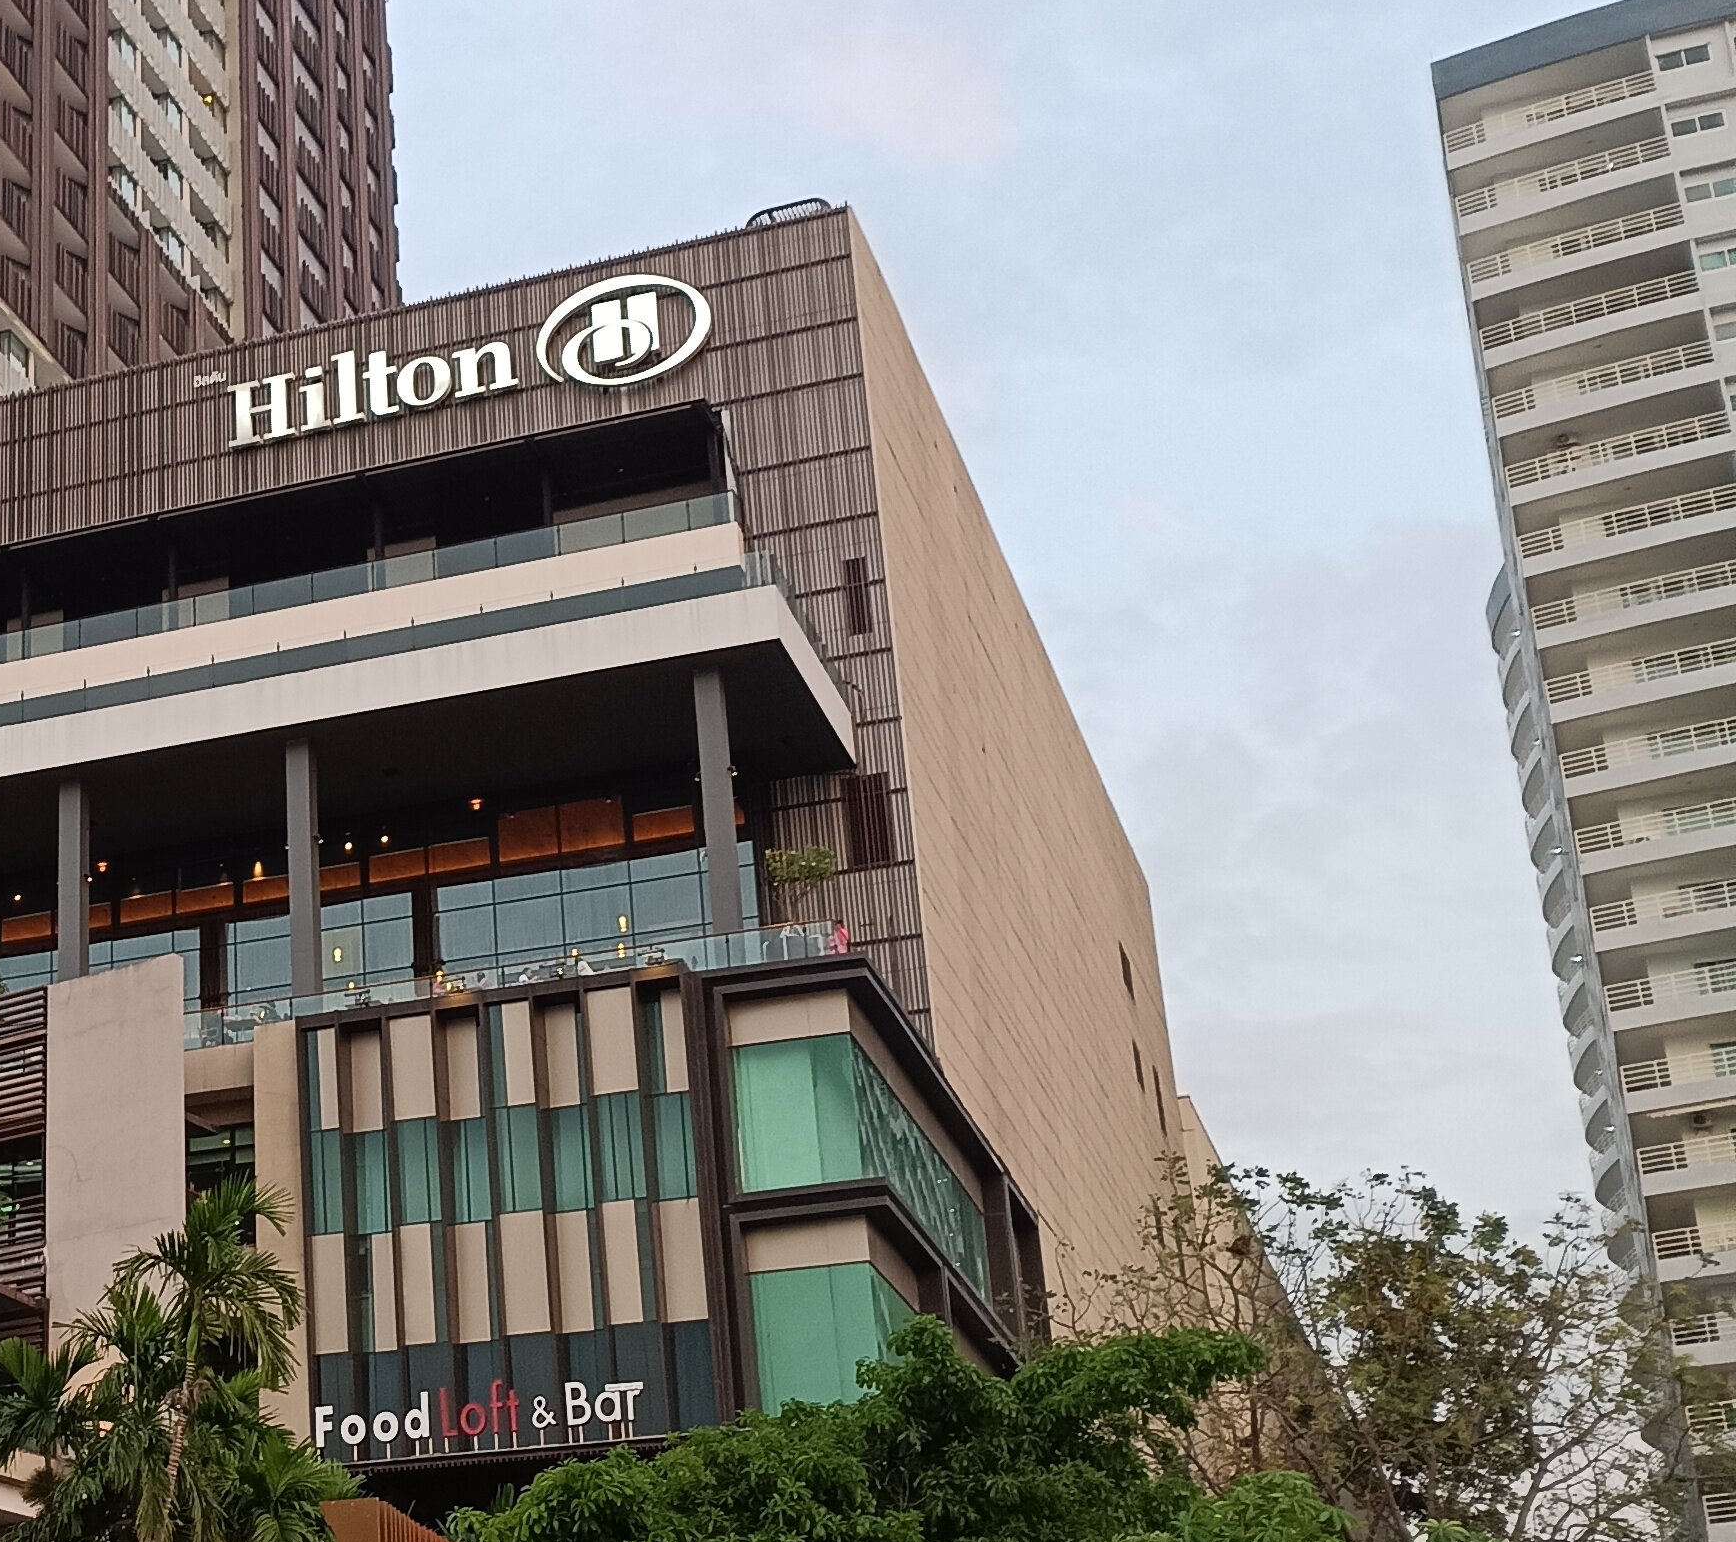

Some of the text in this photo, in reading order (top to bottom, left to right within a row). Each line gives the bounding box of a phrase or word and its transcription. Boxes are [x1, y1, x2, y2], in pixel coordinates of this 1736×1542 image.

[227, 340, 519, 449] Hilton
[314, 1391, 430, 1448] Food
[438, 1379, 520, 1438] Loft
[531, 1395, 557, 1429] &
